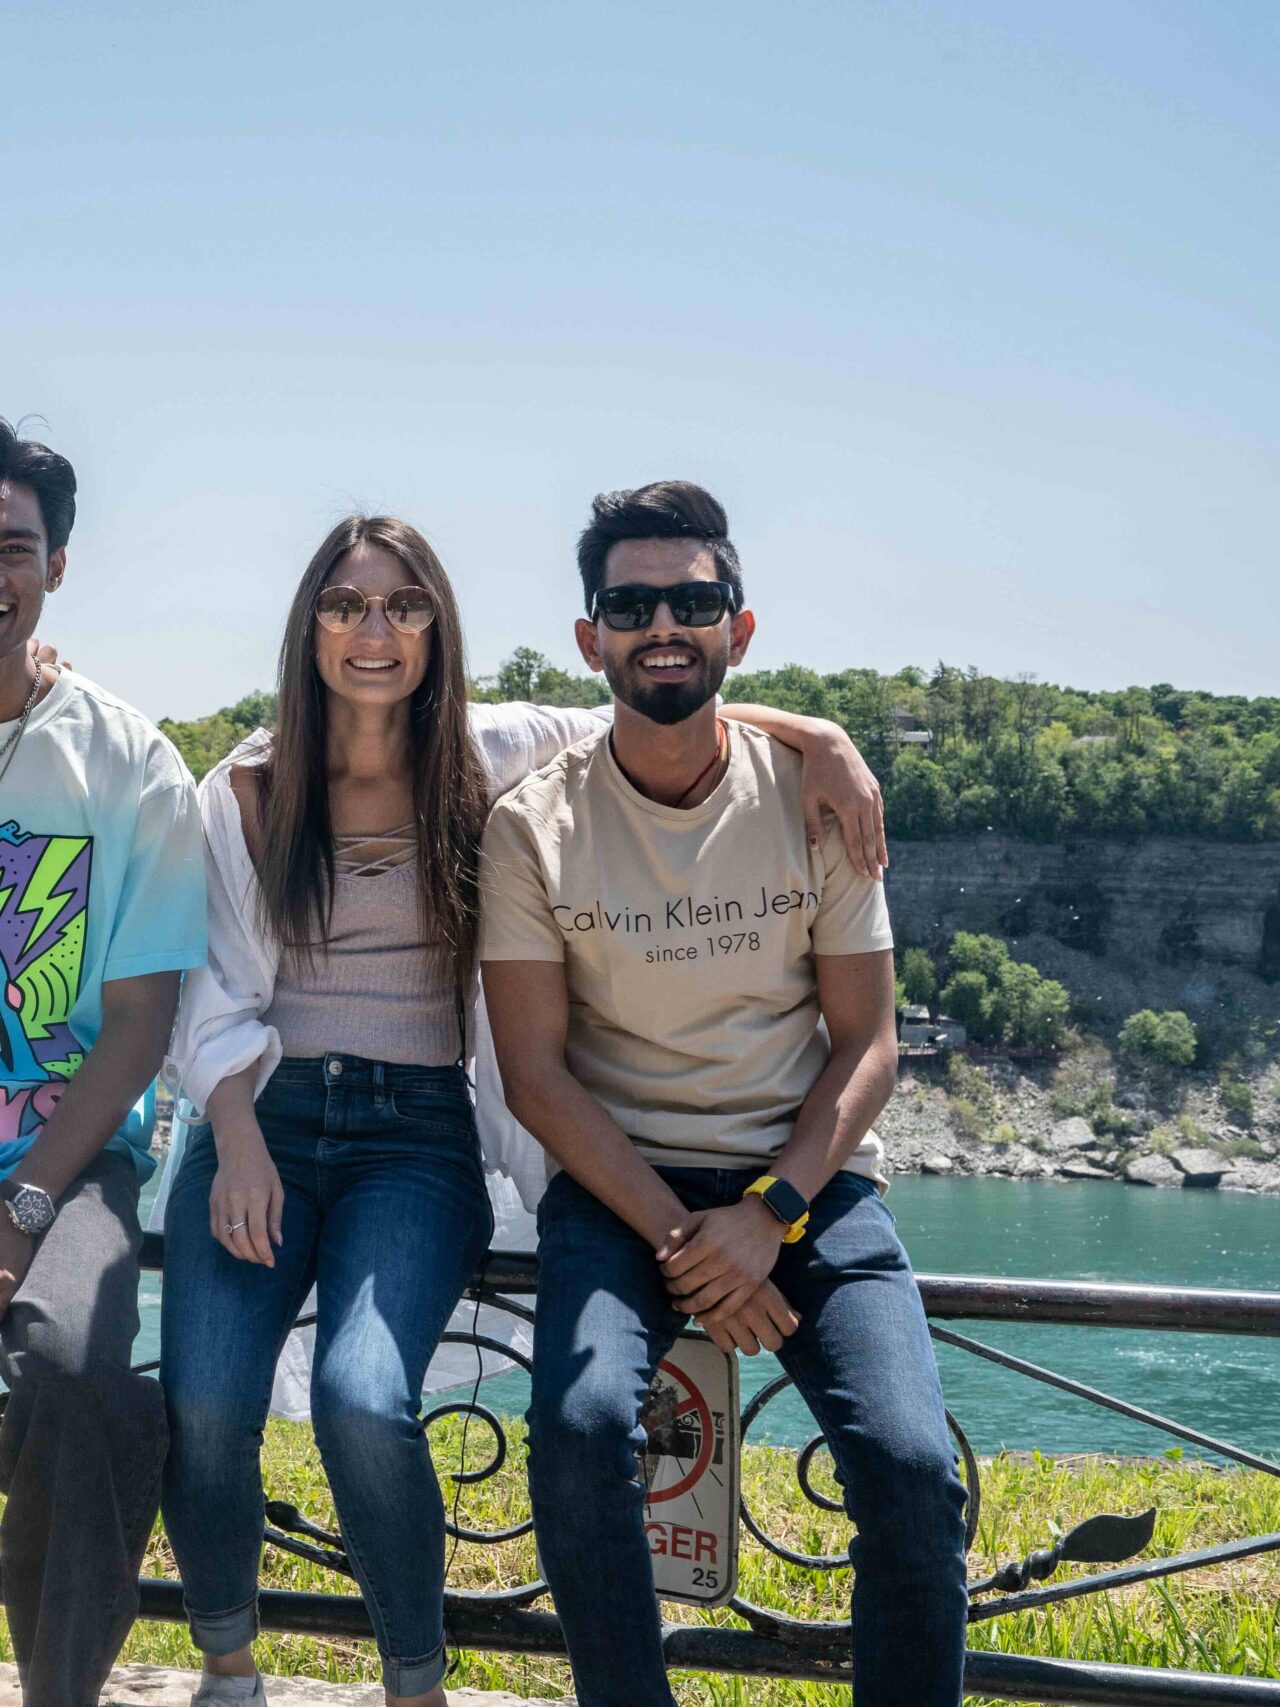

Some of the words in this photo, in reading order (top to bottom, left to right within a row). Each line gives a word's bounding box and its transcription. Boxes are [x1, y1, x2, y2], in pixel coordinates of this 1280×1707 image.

[552, 899, 651, 933] Calvin
[666, 896, 742, 929] Klein
[753, 886, 824, 918] Jean
[645, 945, 698, 963] since
[707, 931, 760, 955] 1978
[644, 1523, 718, 1565] GER
[691, 1567, 718, 1589] 25
